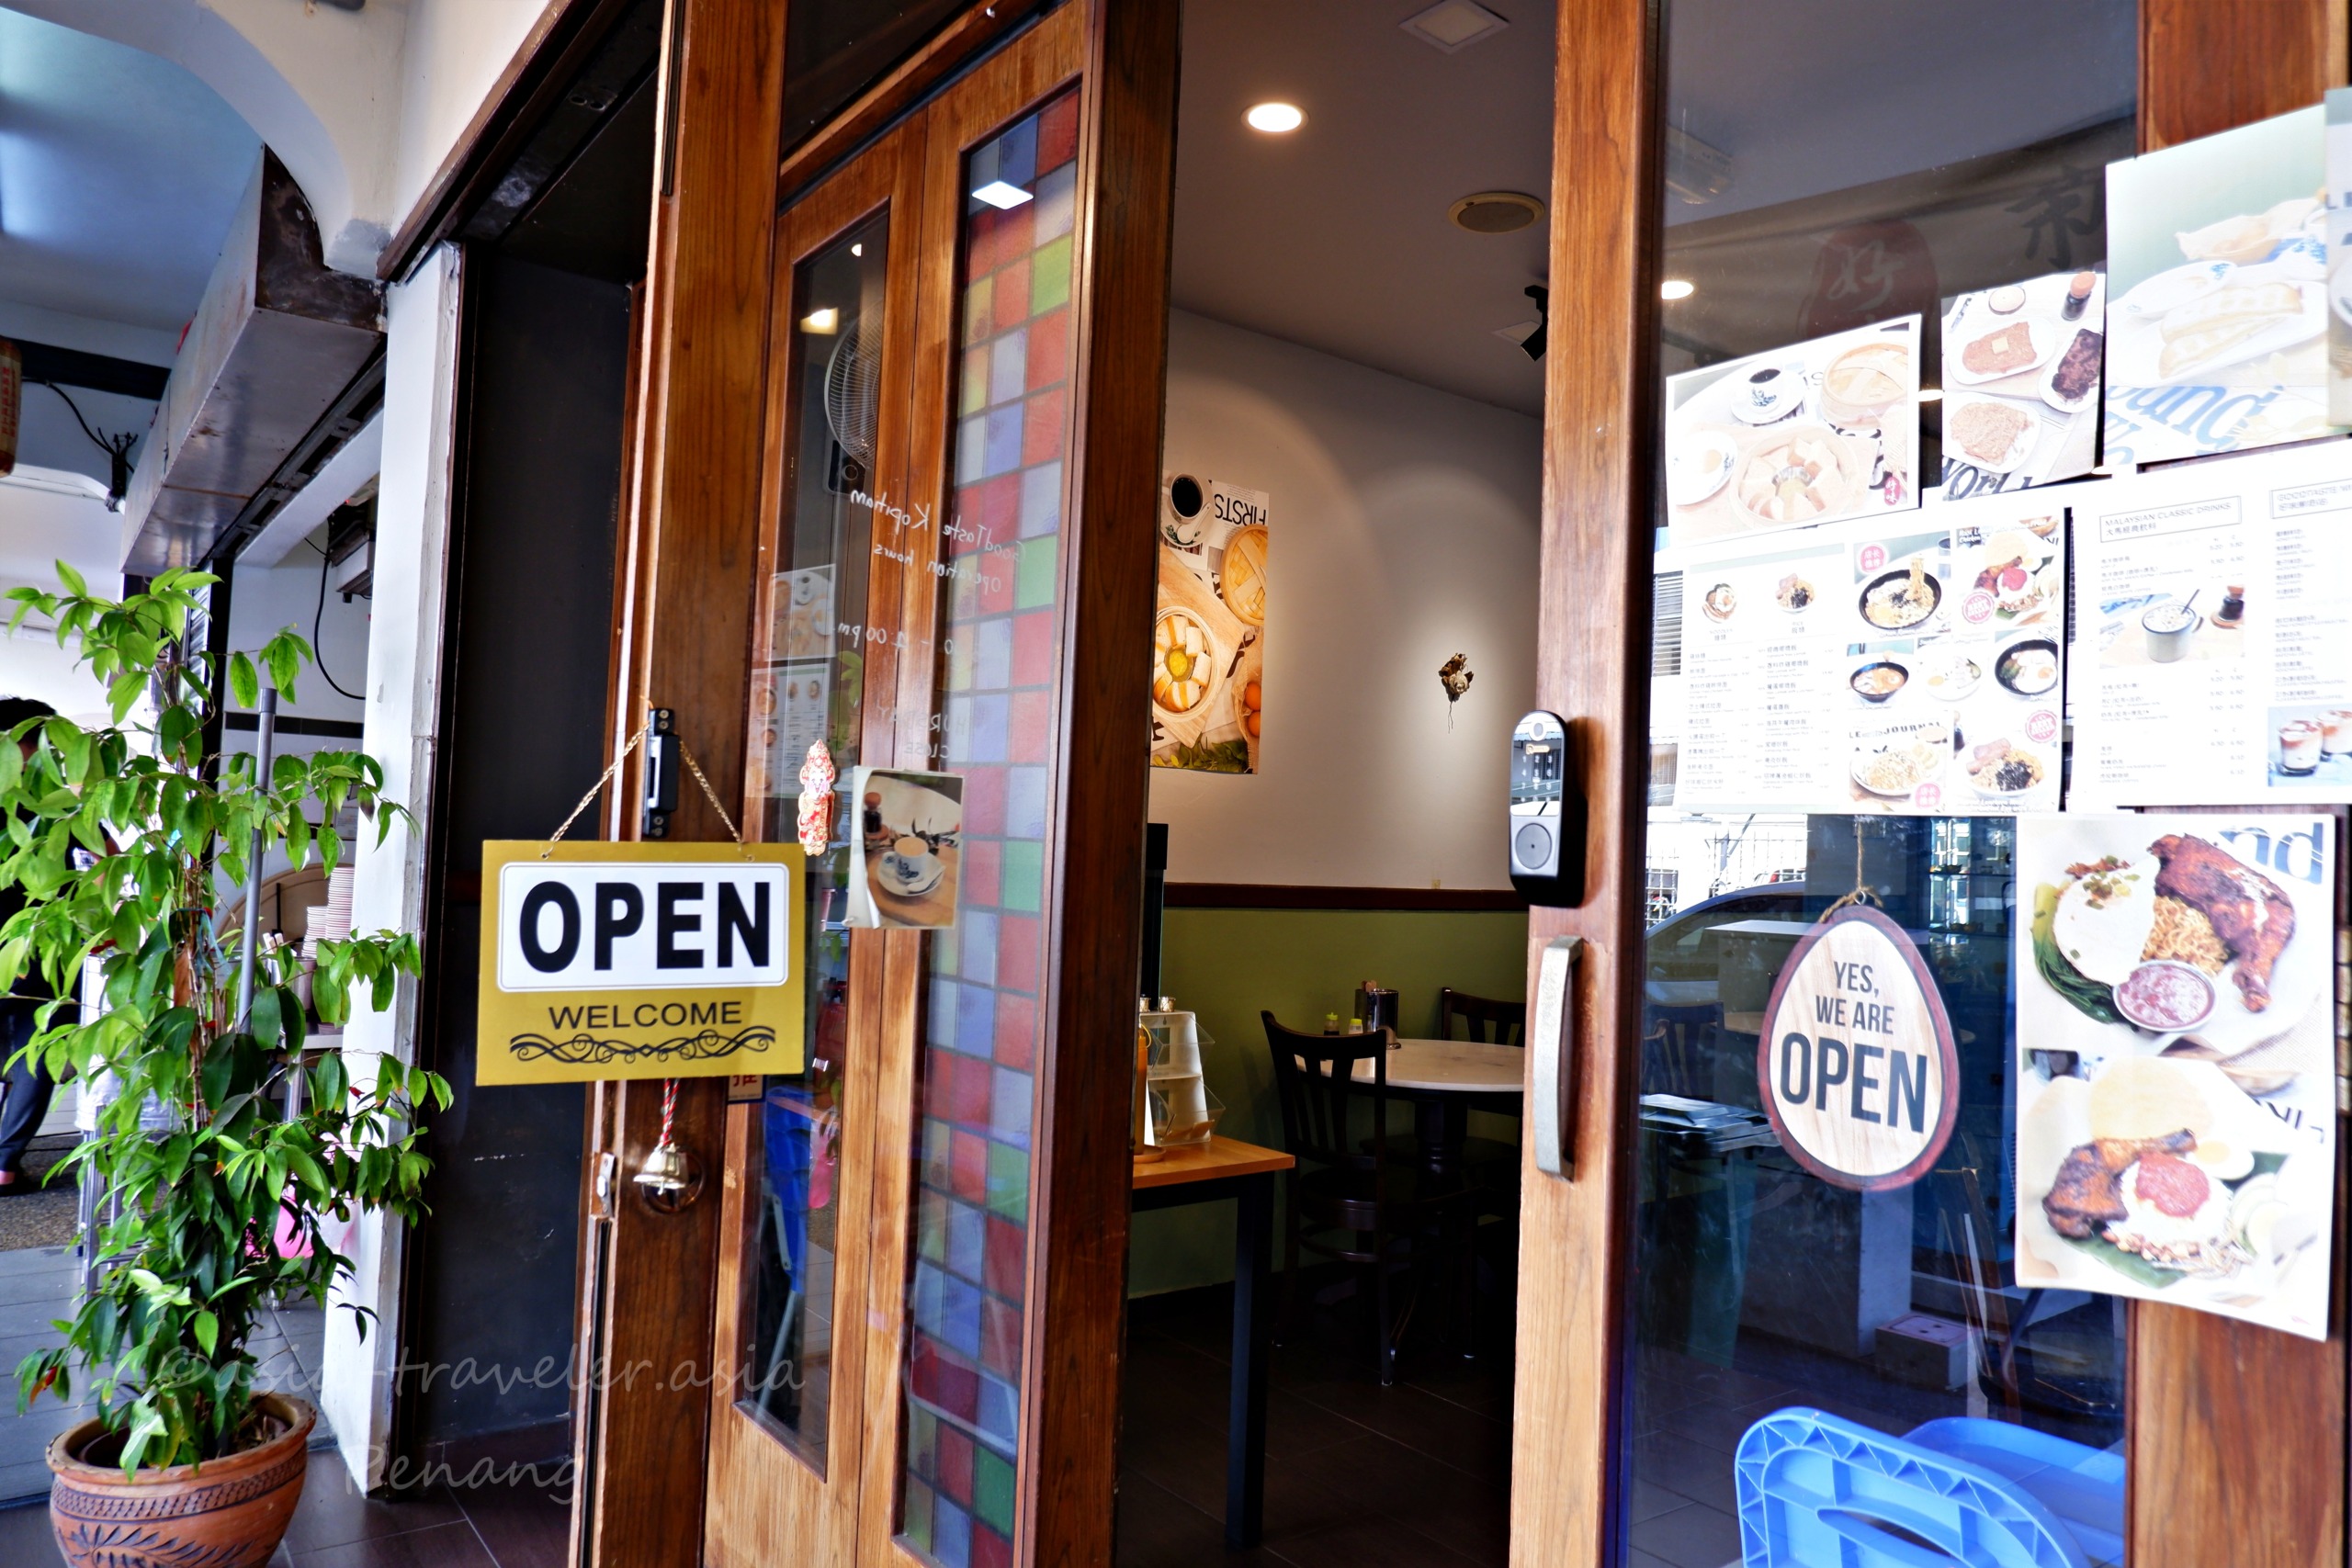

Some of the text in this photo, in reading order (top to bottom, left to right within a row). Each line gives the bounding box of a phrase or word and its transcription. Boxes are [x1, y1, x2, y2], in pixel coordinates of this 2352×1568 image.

[519, 880, 771, 973] OPEN
[1833, 961, 1880, 998] YES,
[548, 1001, 742, 1030] WELCOME
[1815, 995, 1895, 1035] WE ARE
[1780, 1032, 1928, 1134] OPEN
